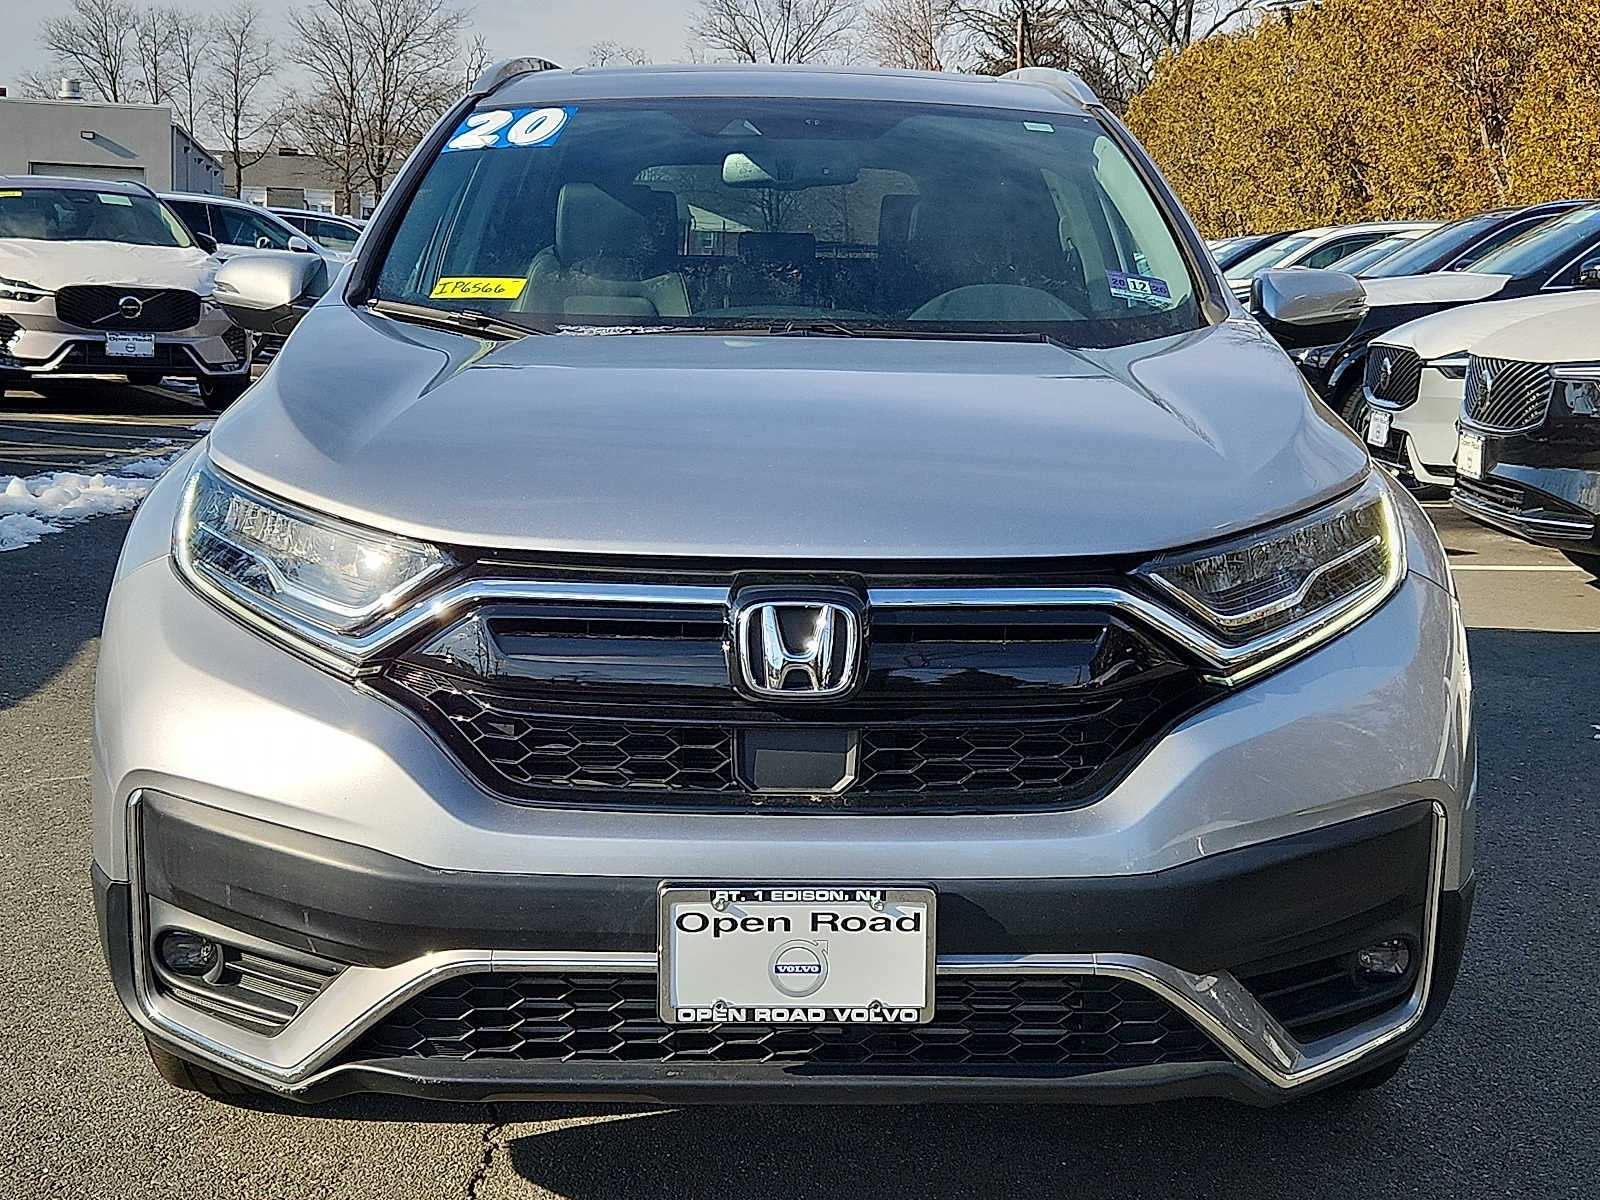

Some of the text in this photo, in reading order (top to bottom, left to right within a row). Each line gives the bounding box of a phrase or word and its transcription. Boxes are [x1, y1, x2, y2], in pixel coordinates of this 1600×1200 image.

[448, 107, 568, 150] 20
[1130, 280, 1148, 292] 12
[753, 889, 764, 902] 1
[855, 889, 882, 902] NJ
[675, 911, 921, 938] Open Road
[776, 964, 820, 974] VOLVO
[677, 1007, 919, 1023] OPEN ROAD VOLVO
